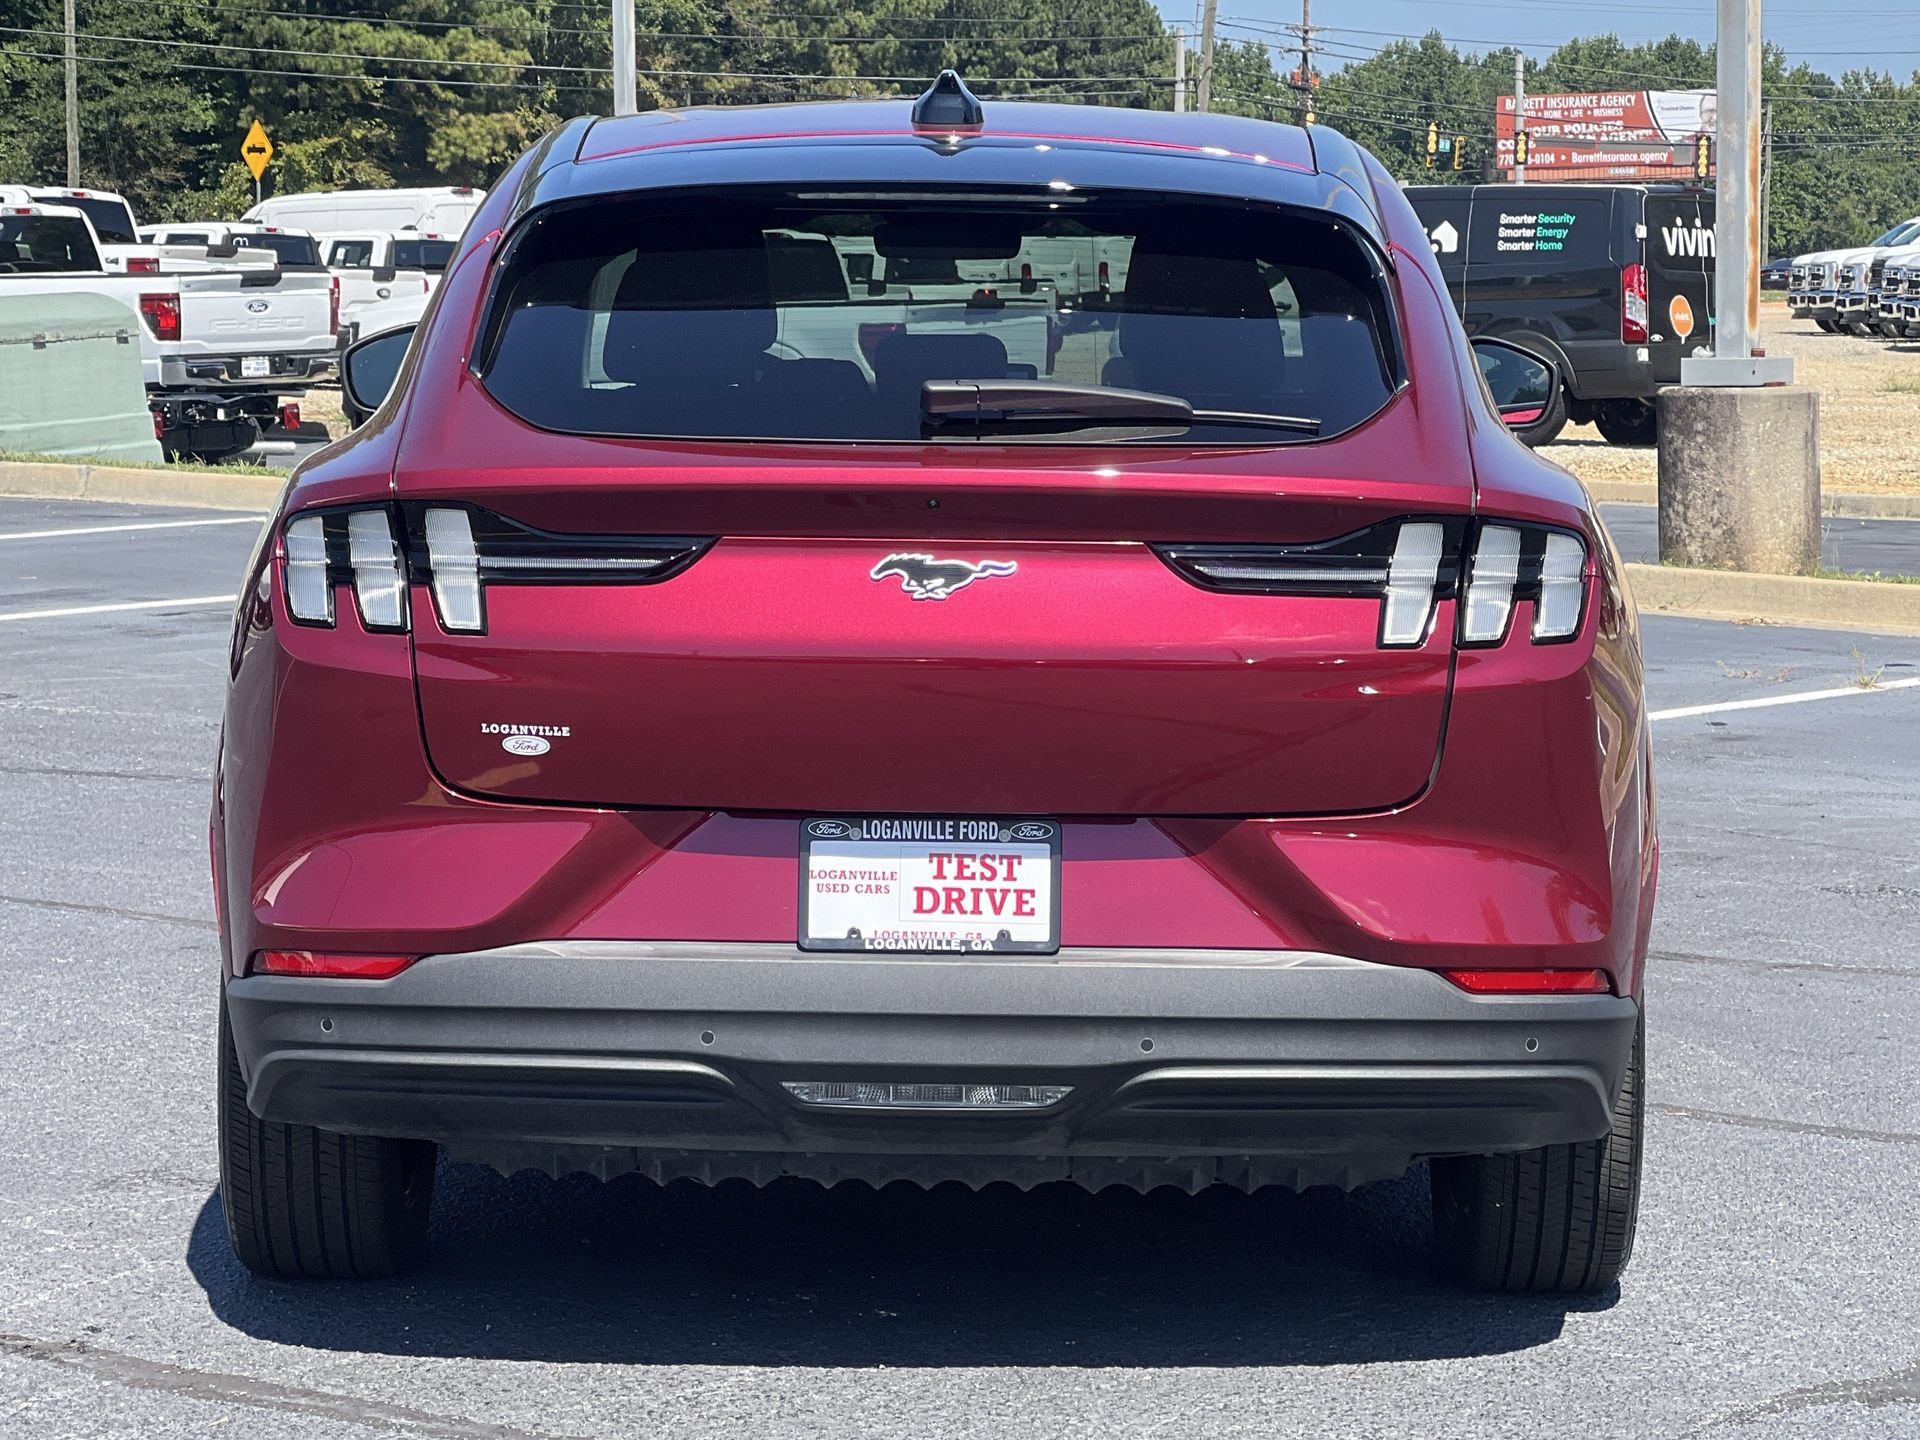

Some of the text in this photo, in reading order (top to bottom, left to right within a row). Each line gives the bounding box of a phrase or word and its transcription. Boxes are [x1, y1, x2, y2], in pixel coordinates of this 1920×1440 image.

[1505, 95, 1636, 110] BARETT INSURANCE AGENCY
[1543, 110, 1562, 118] HOME
[1593, 108, 1623, 116] BUSINESS
[1563, 121, 1624, 134] POLICIES
[1500, 213, 1576, 225] Smarter Security
[1498, 226, 1569, 239] Smarter Energy
[1662, 216, 1716, 257] vivin
[1497, 240, 1563, 251] Smarter Home
[481, 723, 570, 736] LOGANVILLE
[512, 740, 540, 752] Ford
[816, 820, 1045, 841] Ford LOGANVILLE FORD Ford
[929, 853, 1022, 881] TEST
[810, 869, 898, 881] LOGANVILLE
[816, 883, 890, 895] USED CARS
[913, 886, 1035, 916] DRIVE
[864, 938, 994, 953] LOGANVILLE, GA
